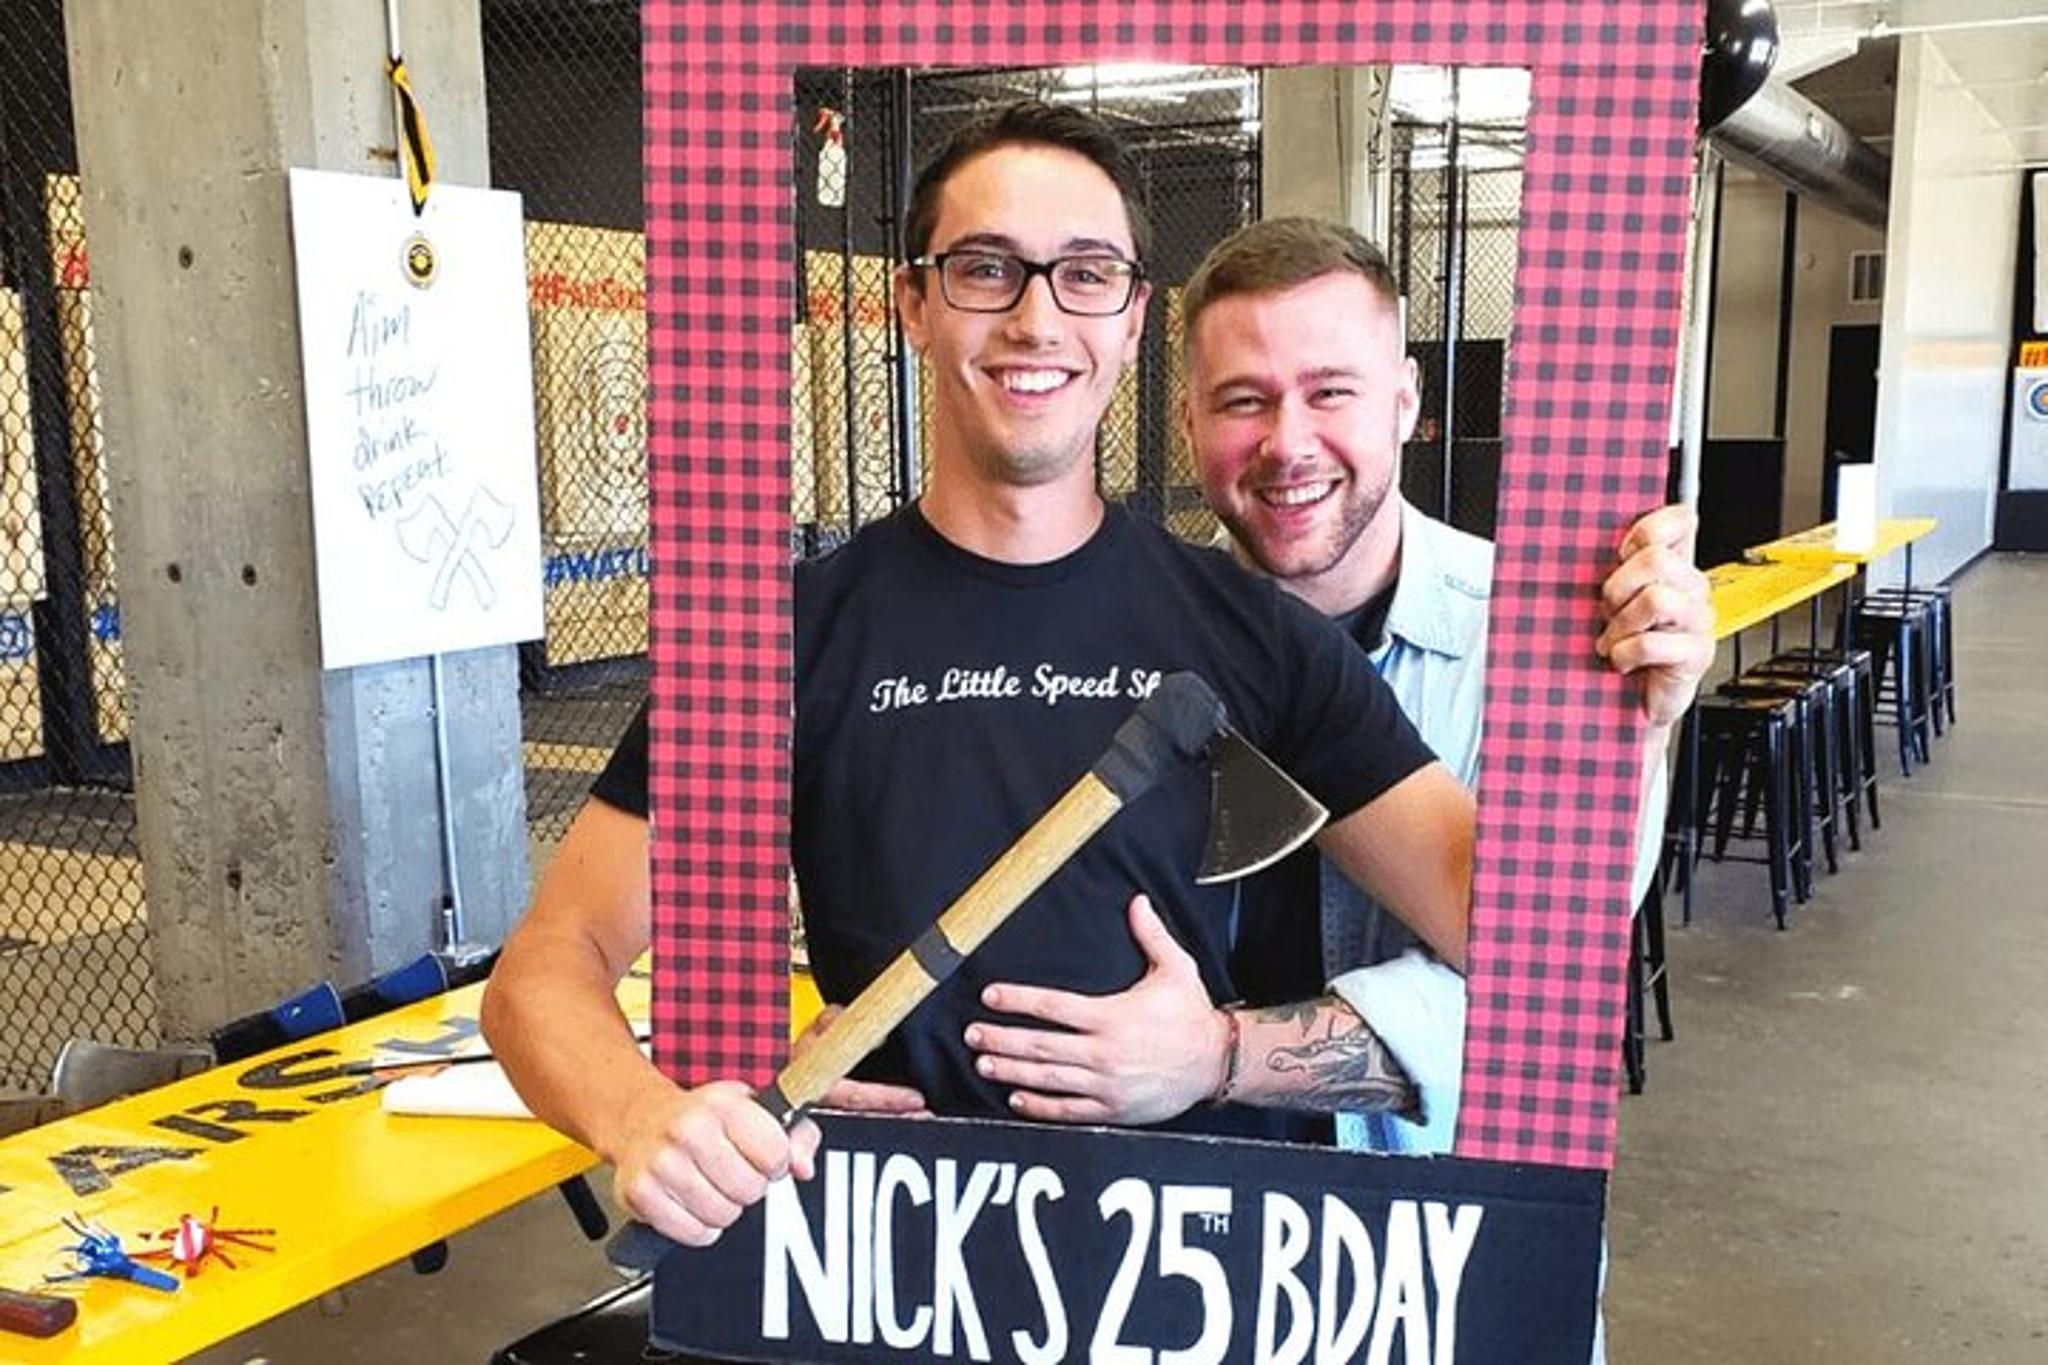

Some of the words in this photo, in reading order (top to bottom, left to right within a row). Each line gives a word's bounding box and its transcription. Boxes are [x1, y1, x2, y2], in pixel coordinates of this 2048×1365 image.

[346, 290, 411, 358] Aim
[344, 363, 438, 416] throw
[353, 414, 431, 471] drink
[869, 675, 929, 713] The
[935, 665, 1022, 702] Little
[1031, 663, 1120, 706] Speed
[762, 1150, 1068, 1365] NICK'S
[1089, 1177, 1233, 1365] 25
[1200, 1212, 1230, 1234] TH
[1254, 1190, 1484, 1365] BDAY
